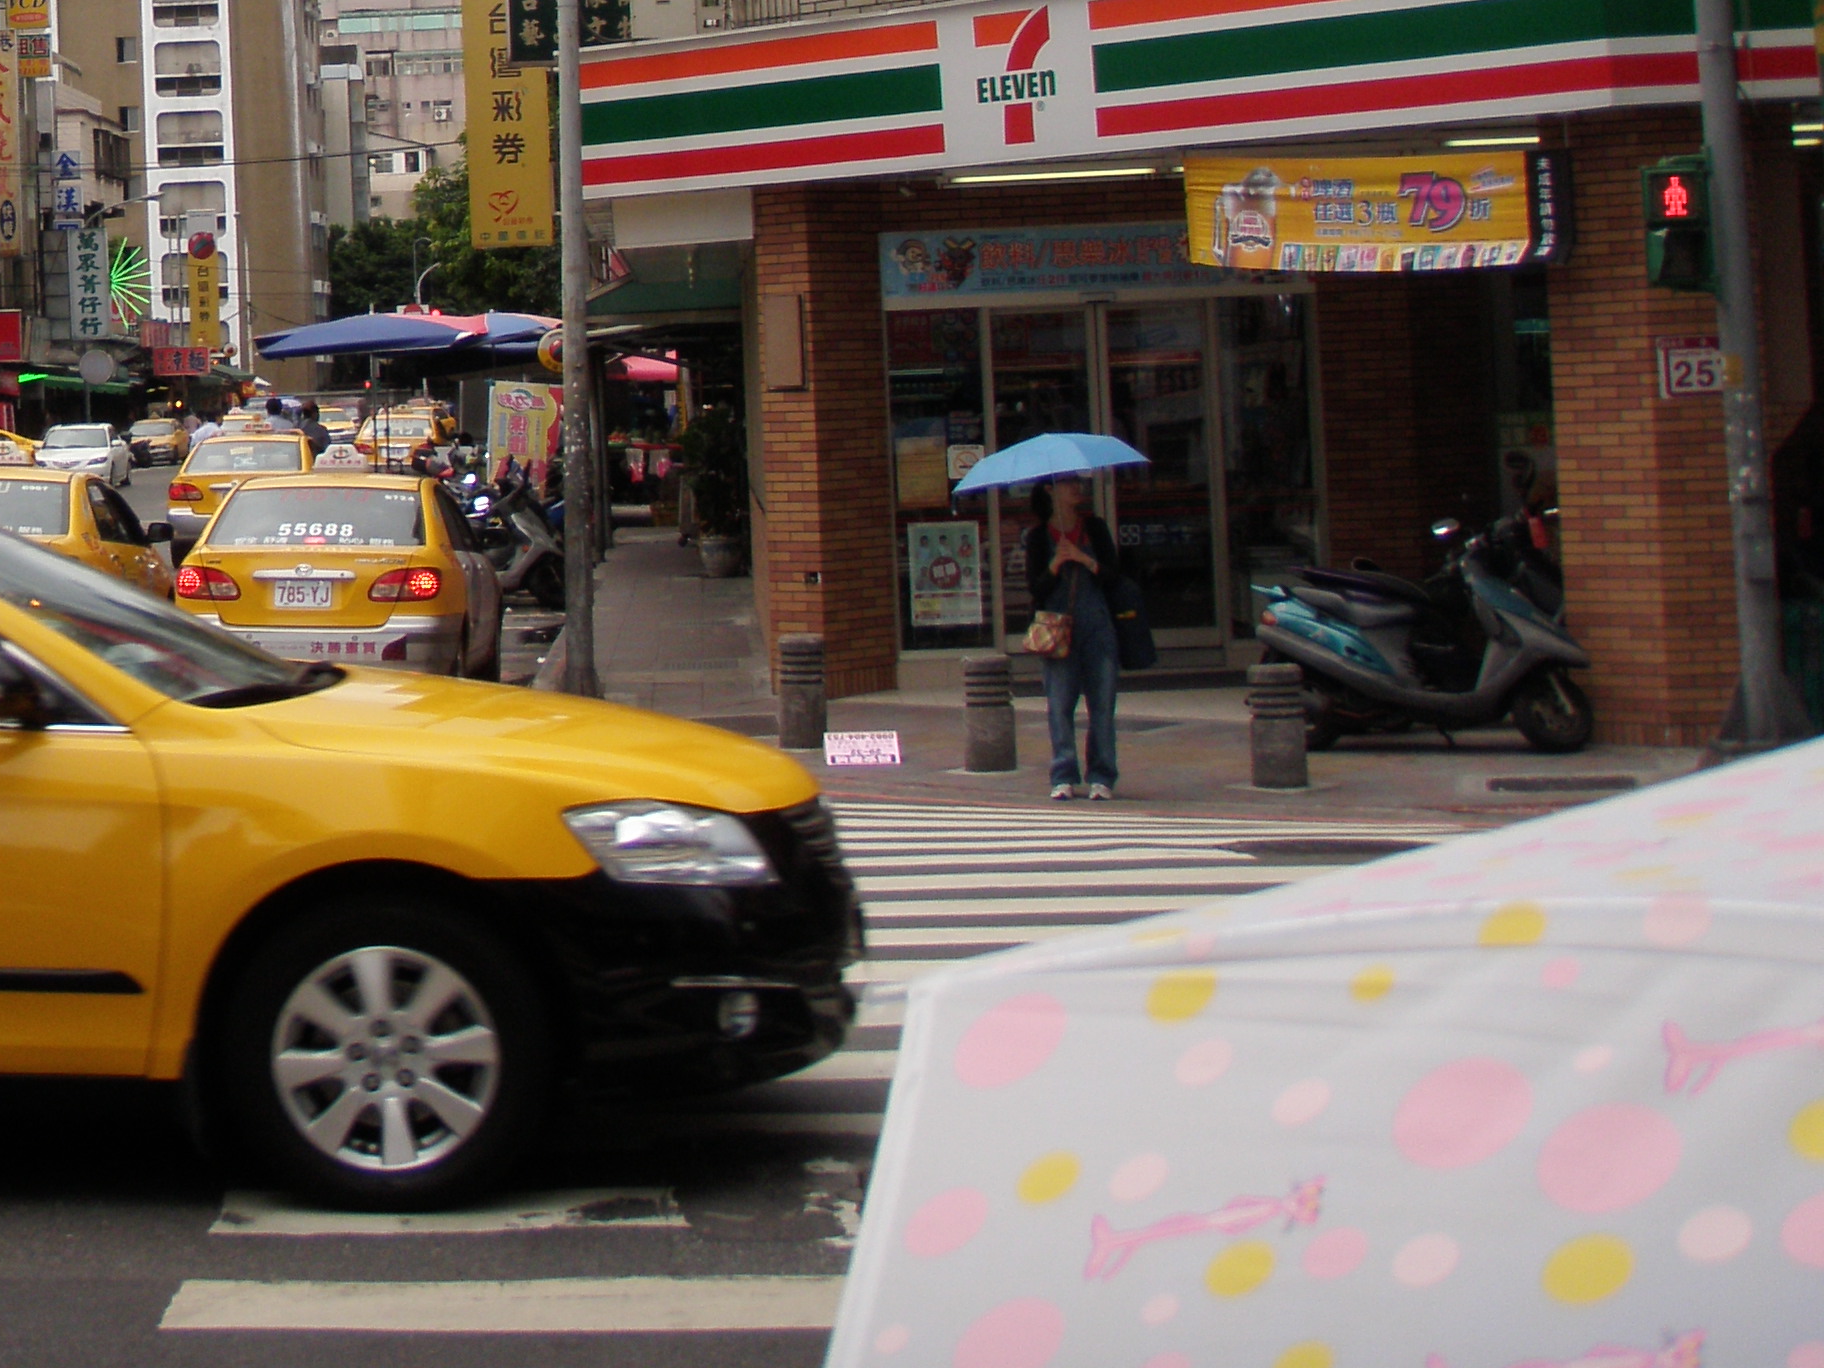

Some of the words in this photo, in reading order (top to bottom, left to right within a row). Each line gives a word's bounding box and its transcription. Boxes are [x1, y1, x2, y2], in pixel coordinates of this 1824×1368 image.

[55, 152, 79, 230] 金漢
[277, 522, 355, 537] 55688
[277, 584, 330, 605] 785-YJ
